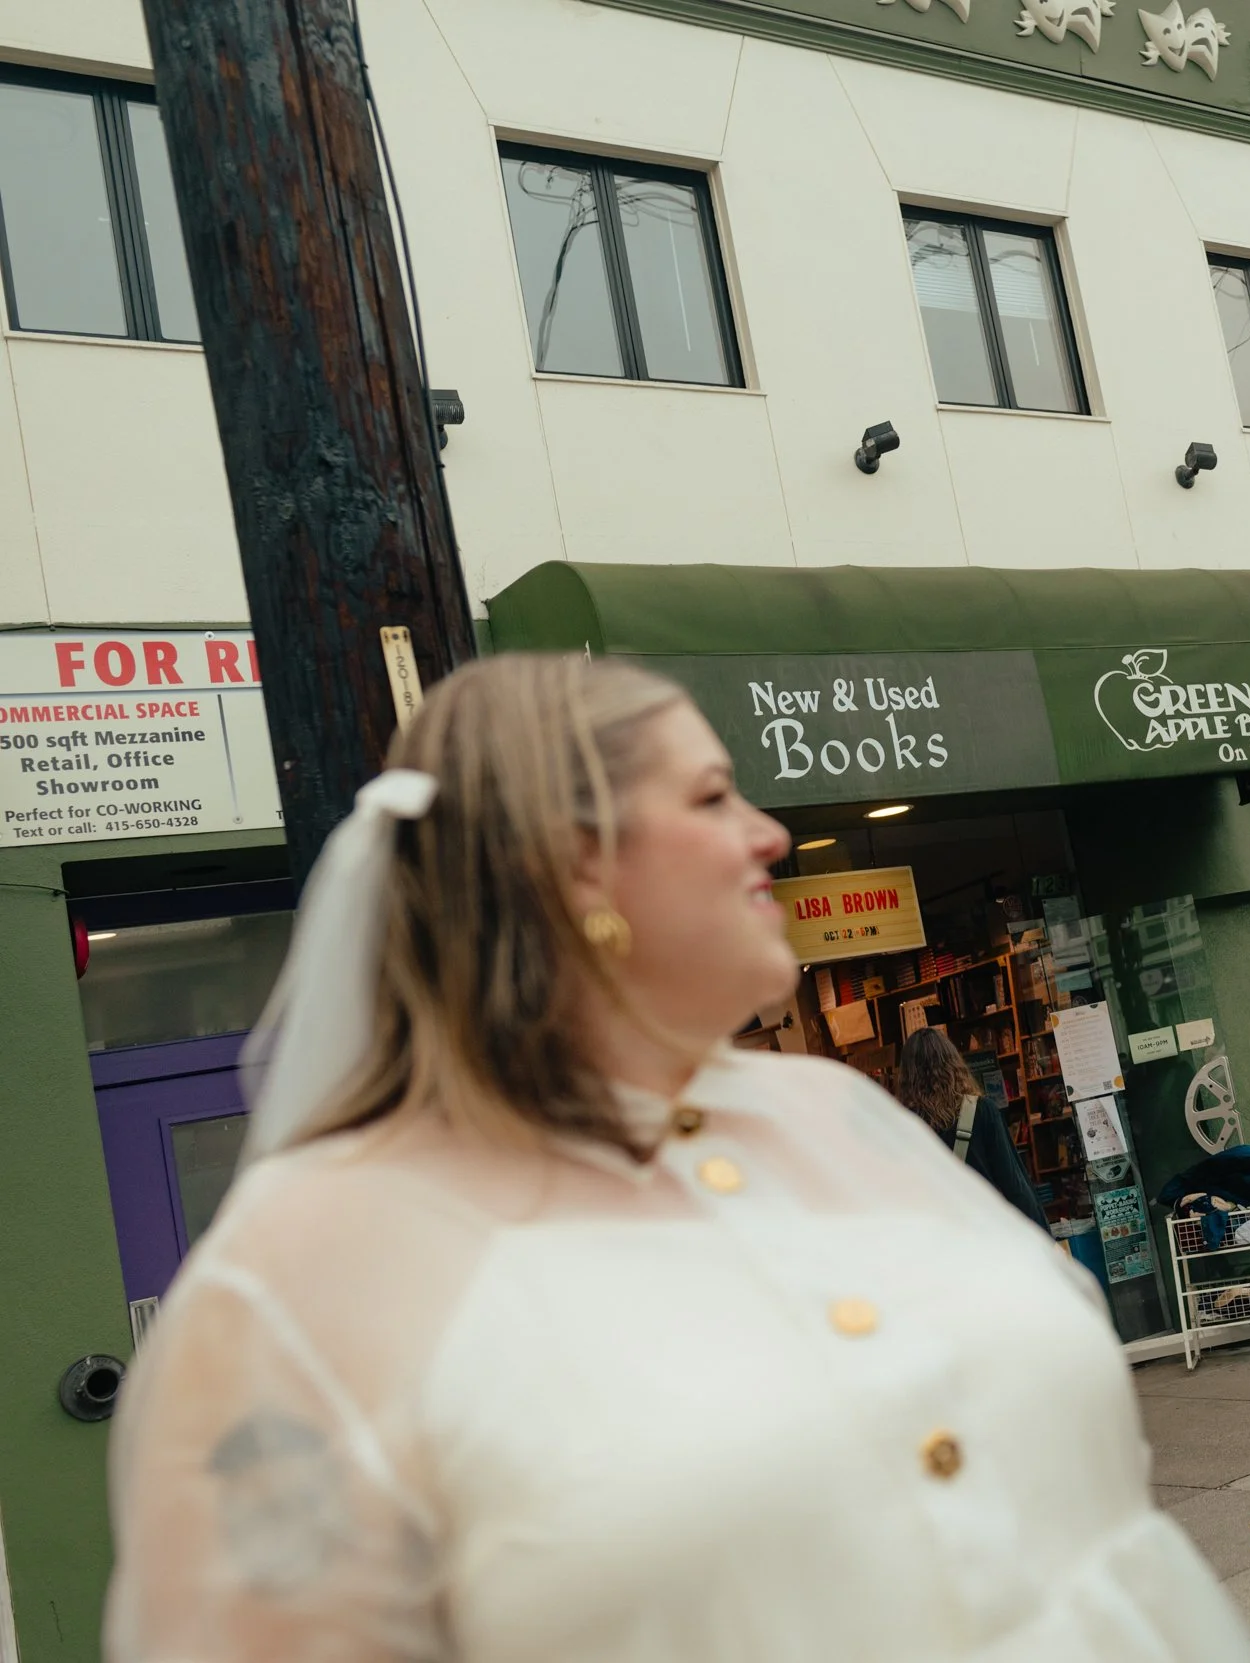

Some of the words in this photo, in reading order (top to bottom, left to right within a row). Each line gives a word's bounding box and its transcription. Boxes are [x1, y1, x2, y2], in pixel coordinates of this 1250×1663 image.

[54, 640, 184, 688] FOR
[748, 681, 821, 716] New
[832, 678, 860, 713] &
[864, 676, 941, 711] Used
[136, 701, 200, 719] SPACE
[46, 730, 89, 752] sqft
[95, 728, 206, 747] Mezzanine
[1145, 716, 1232, 743] APPLE
[761, 712, 948, 780] Books
[1218, 743, 1248, 763] On
[20, 753, 98, 773] Retail,
[107, 751, 175, 769] Office
[36, 775, 160, 796] Showroom
[5, 808, 63, 823] Perfect
[68, 806, 91, 818] for
[96, 799, 203, 817] CO-WORKING
[13, 827, 46, 839] Text
[48, 826, 63, 836] or
[68, 822, 97, 836] call:
[105, 816, 199, 832] 415-650-4328
[794, 896, 832, 921] LISA
[842, 888, 900, 914] BROWN
[824, 931, 840, 942] OCT
